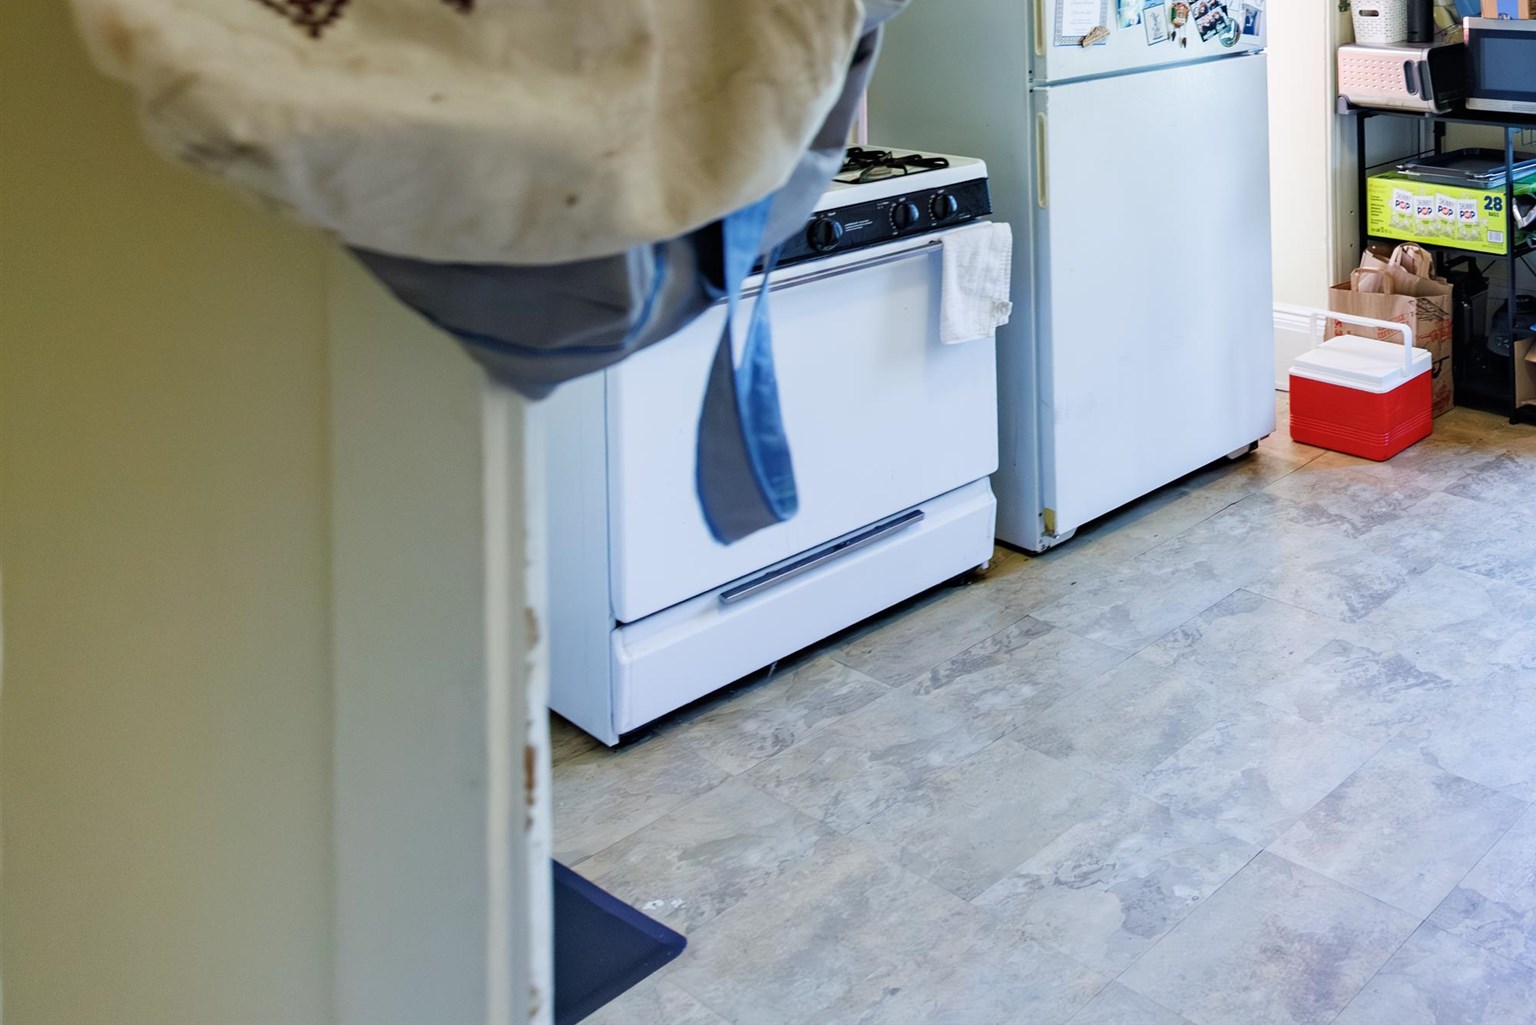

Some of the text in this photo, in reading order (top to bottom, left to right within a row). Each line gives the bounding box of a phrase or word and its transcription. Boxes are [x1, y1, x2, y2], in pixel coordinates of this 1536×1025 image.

[1395, 200, 1410, 209] POP
[1484, 195, 1503, 212] 28
[1417, 207, 1432, 215] POP
[1438, 205, 1453, 216] POP
[1460, 211, 1475, 219] POP
